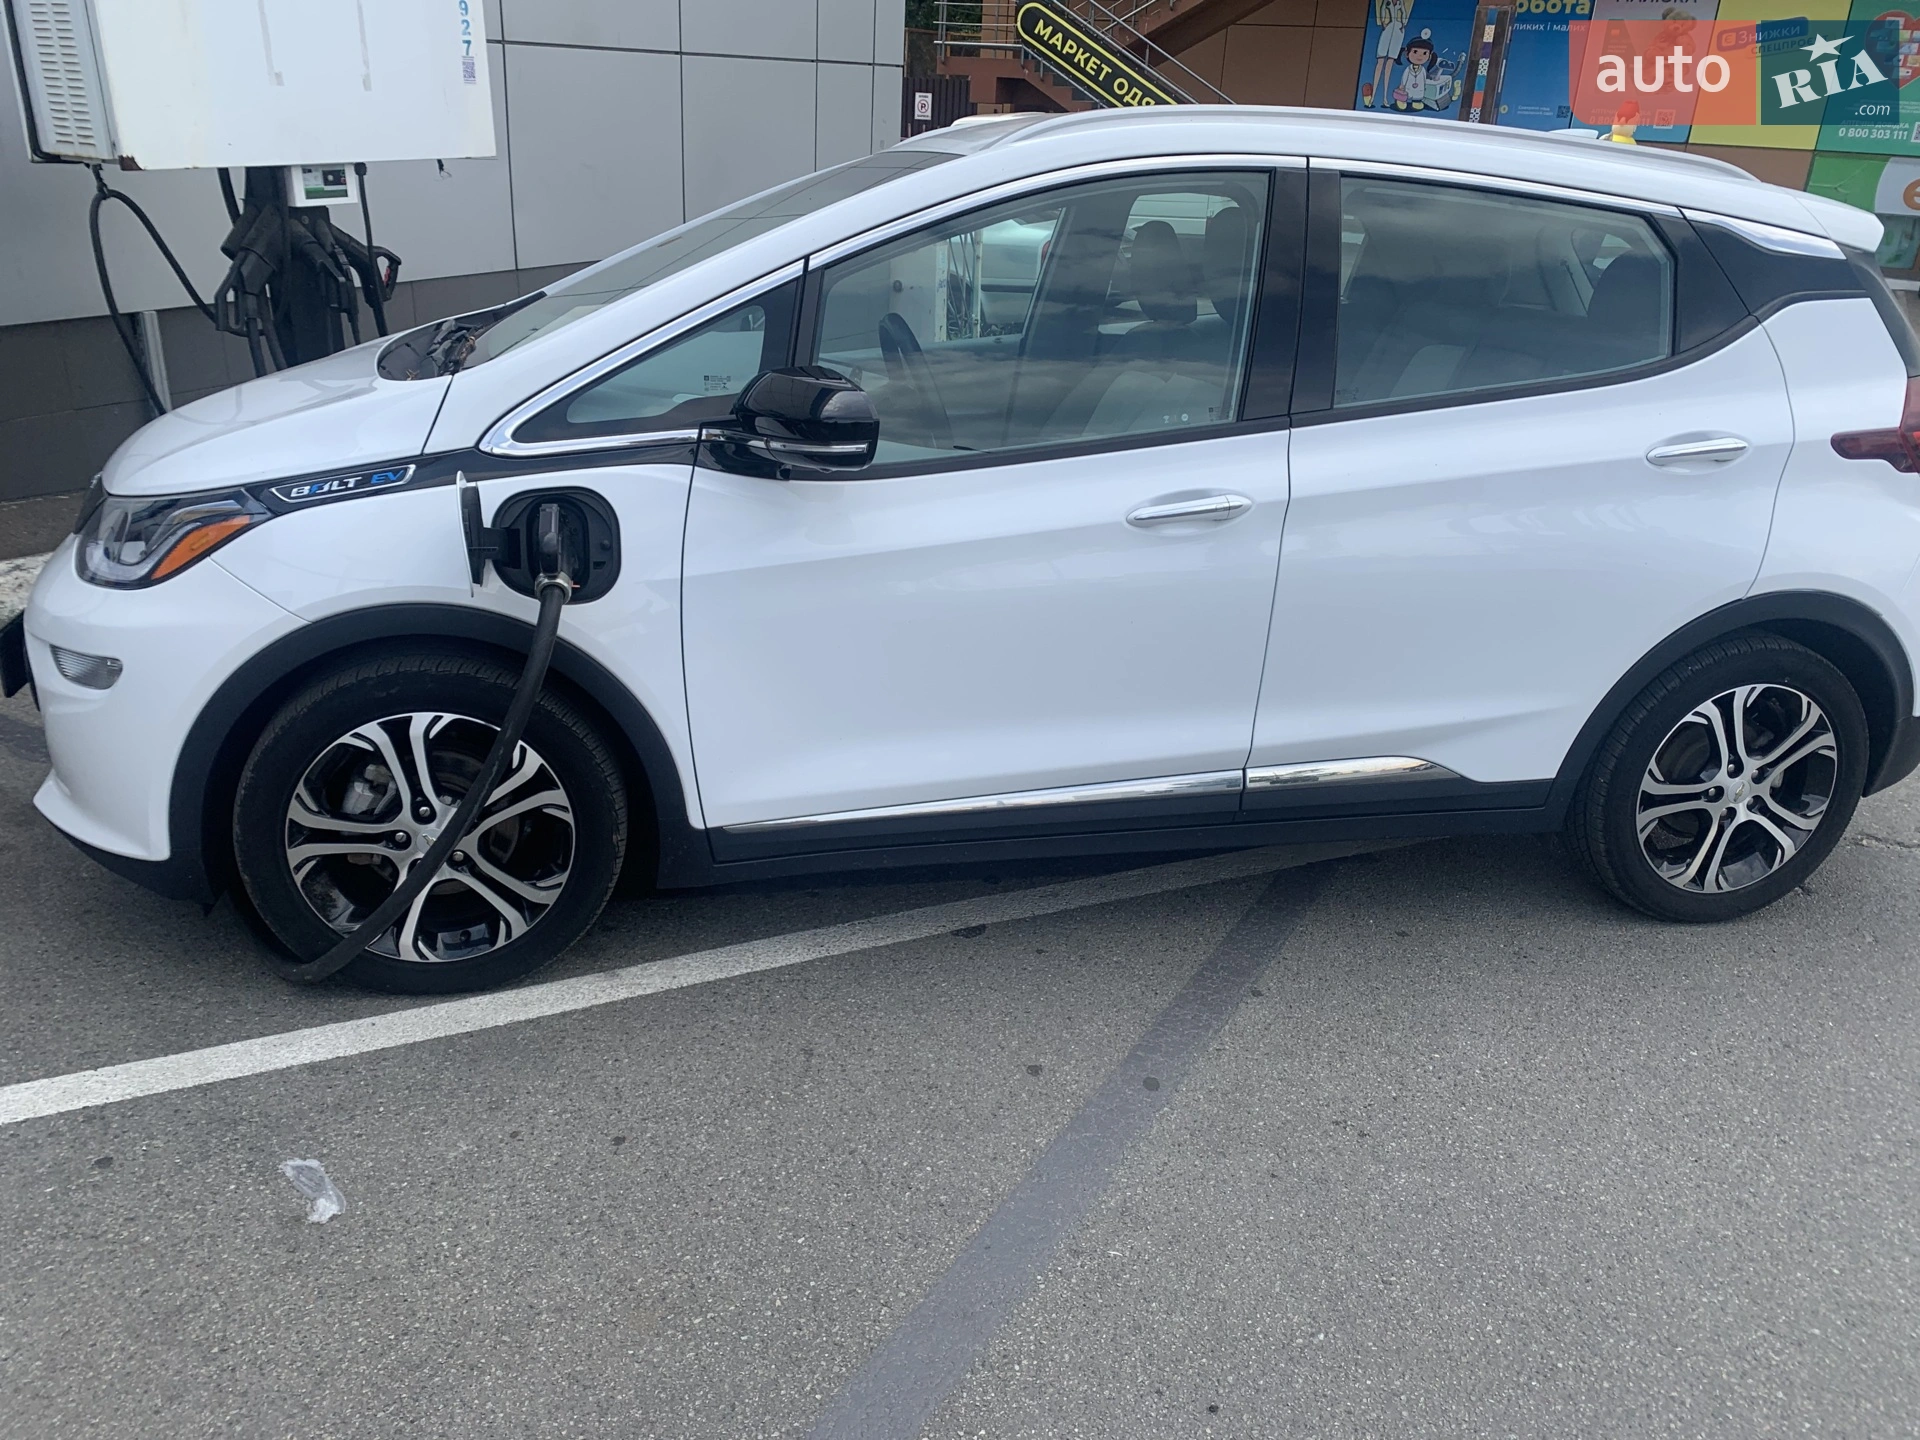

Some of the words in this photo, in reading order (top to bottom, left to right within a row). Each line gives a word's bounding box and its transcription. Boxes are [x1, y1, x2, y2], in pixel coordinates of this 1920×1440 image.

[1513, 23, 1544, 31] ликих
[1034, 18, 1112, 82] МАРКЕТ
[1838, 127, 1846, 137] 0
[1847, 128, 1869, 138] 800
[1870, 129, 1891, 139] 303
[1893, 130, 1908, 140] 111
[290, 476, 362, 497] BOLT
[370, 470, 404, 484] EV
